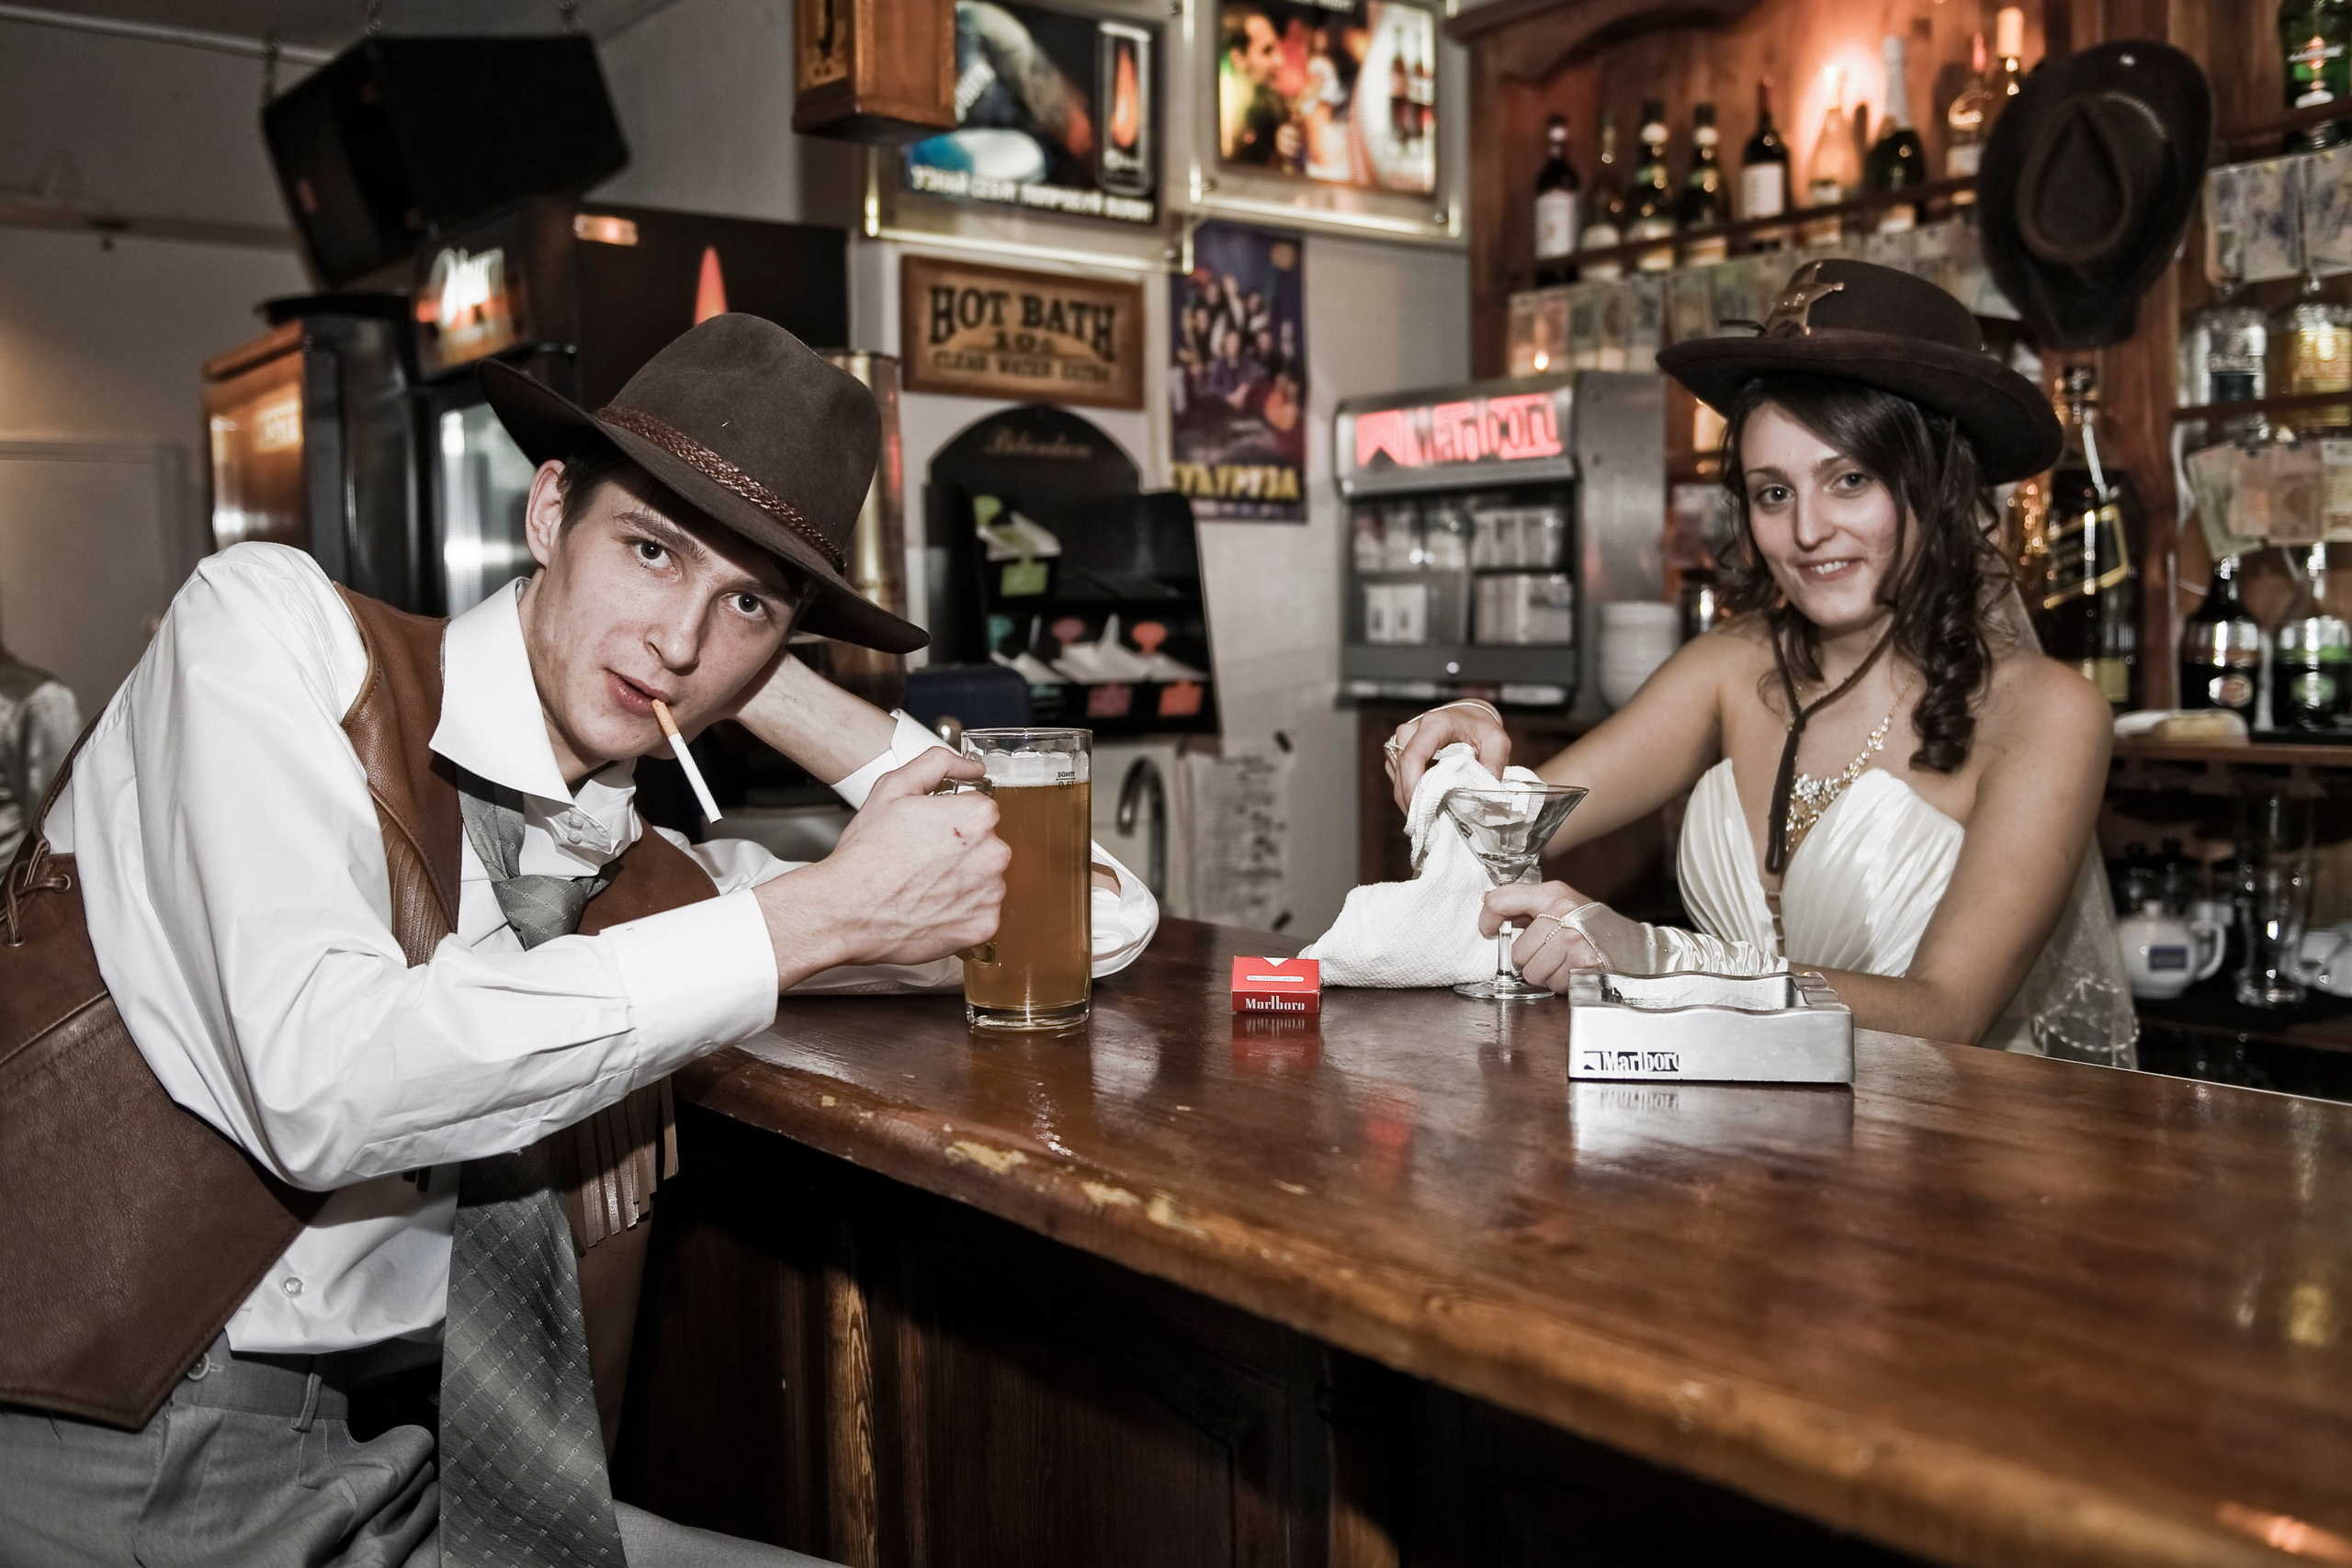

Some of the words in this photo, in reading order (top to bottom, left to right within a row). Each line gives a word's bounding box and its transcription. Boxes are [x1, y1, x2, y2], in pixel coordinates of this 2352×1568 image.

[930, 285, 1010, 345] HOT
[1021, 293, 1115, 364] BATH
[1245, 995, 1305, 1010] Marlboro
